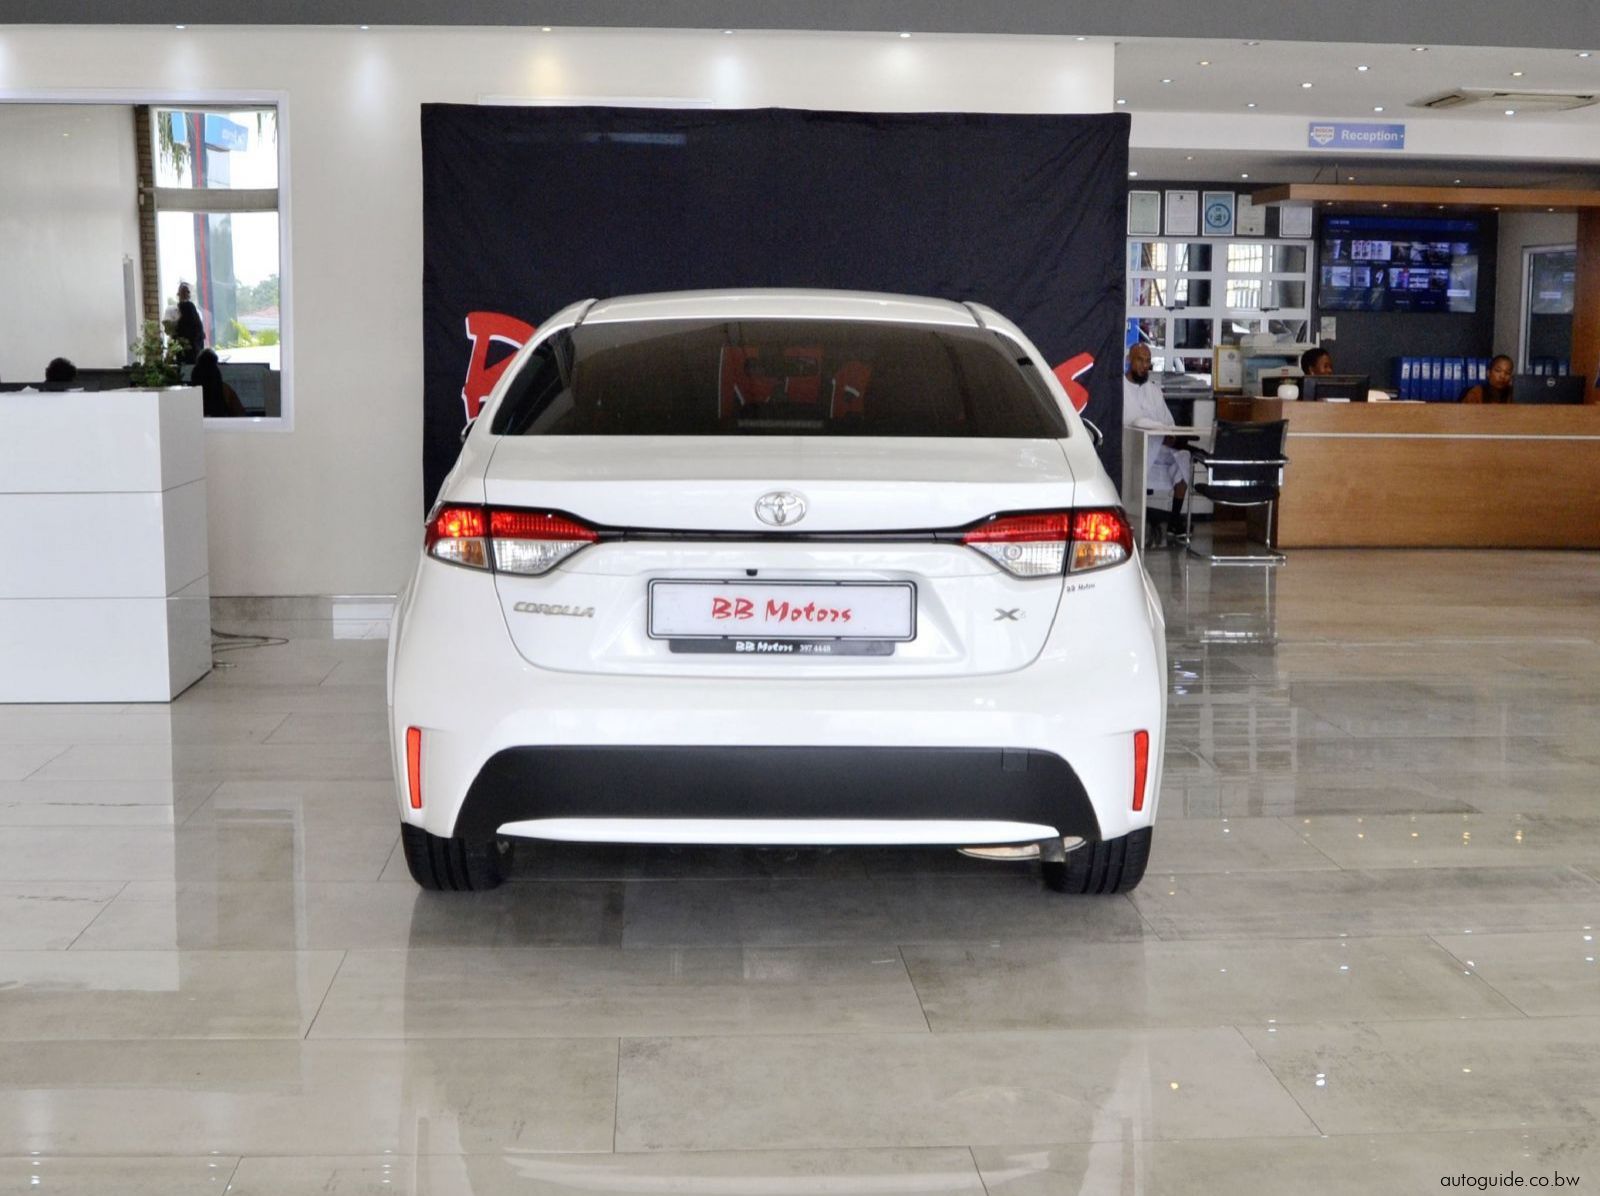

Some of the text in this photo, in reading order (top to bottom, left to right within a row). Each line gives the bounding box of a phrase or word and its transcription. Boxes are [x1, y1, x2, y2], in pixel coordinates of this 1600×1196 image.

[1341, 129, 1398, 143] Reception
[513, 601, 595, 618] COROLLA
[712, 597, 852, 622] BB Motors
[735, 641, 756, 652] BB
[757, 641, 794, 652] Motors
